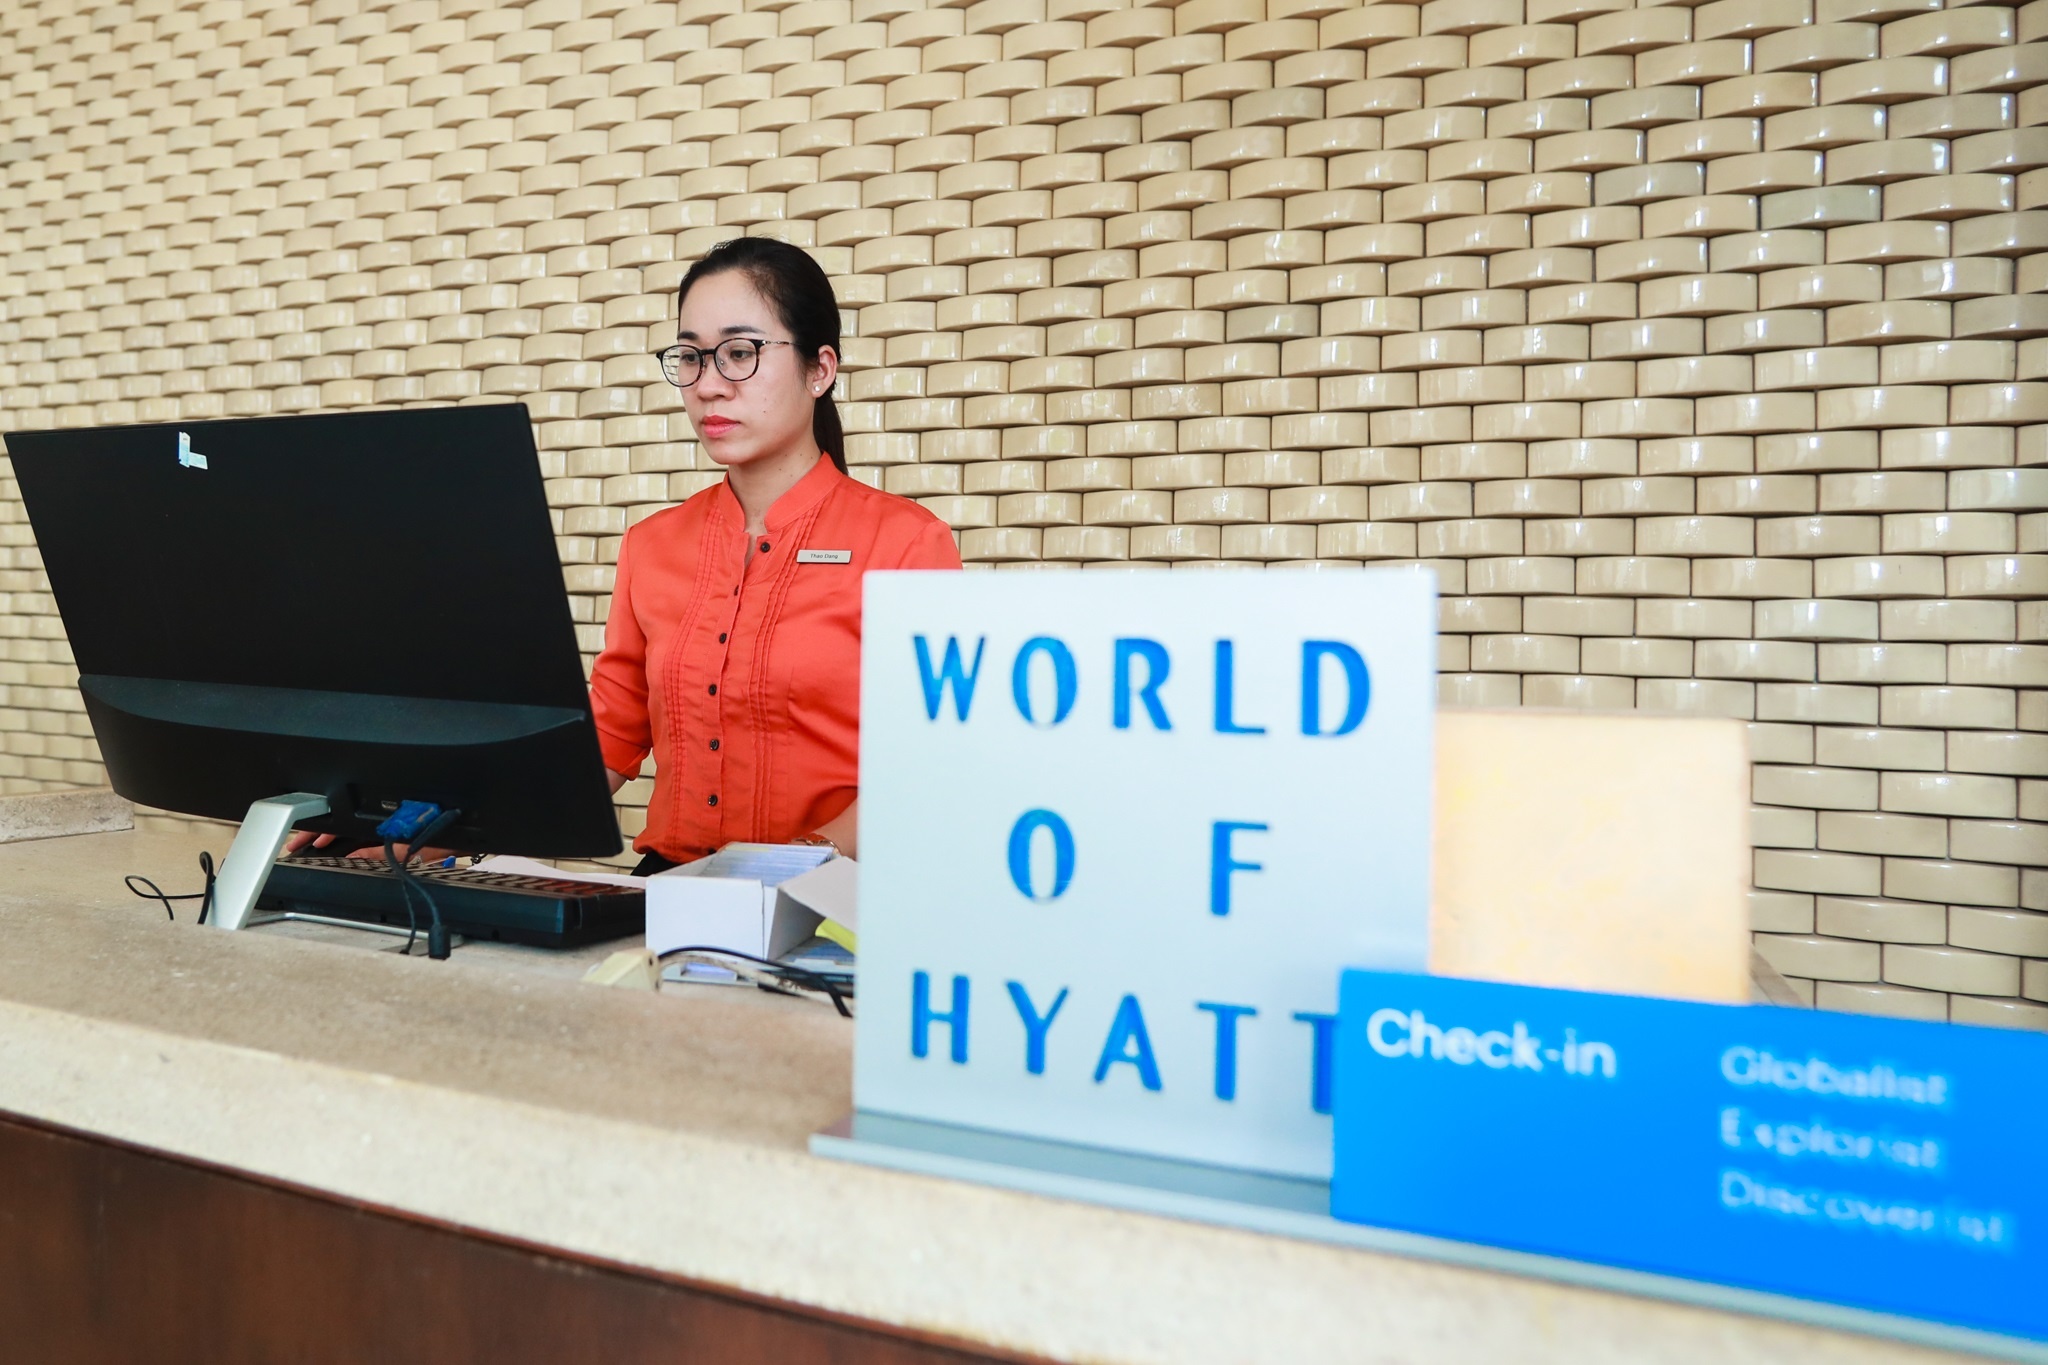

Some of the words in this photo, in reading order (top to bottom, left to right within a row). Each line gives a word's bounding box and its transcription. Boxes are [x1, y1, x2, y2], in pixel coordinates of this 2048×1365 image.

[914, 635, 1371, 737] WORLD
[1006, 808, 1269, 918] OF
[911, 970, 1337, 1114] HYATT
[1366, 1008, 1618, 1077] Check-in
[1720, 1046, 1948, 1105] Globalist
